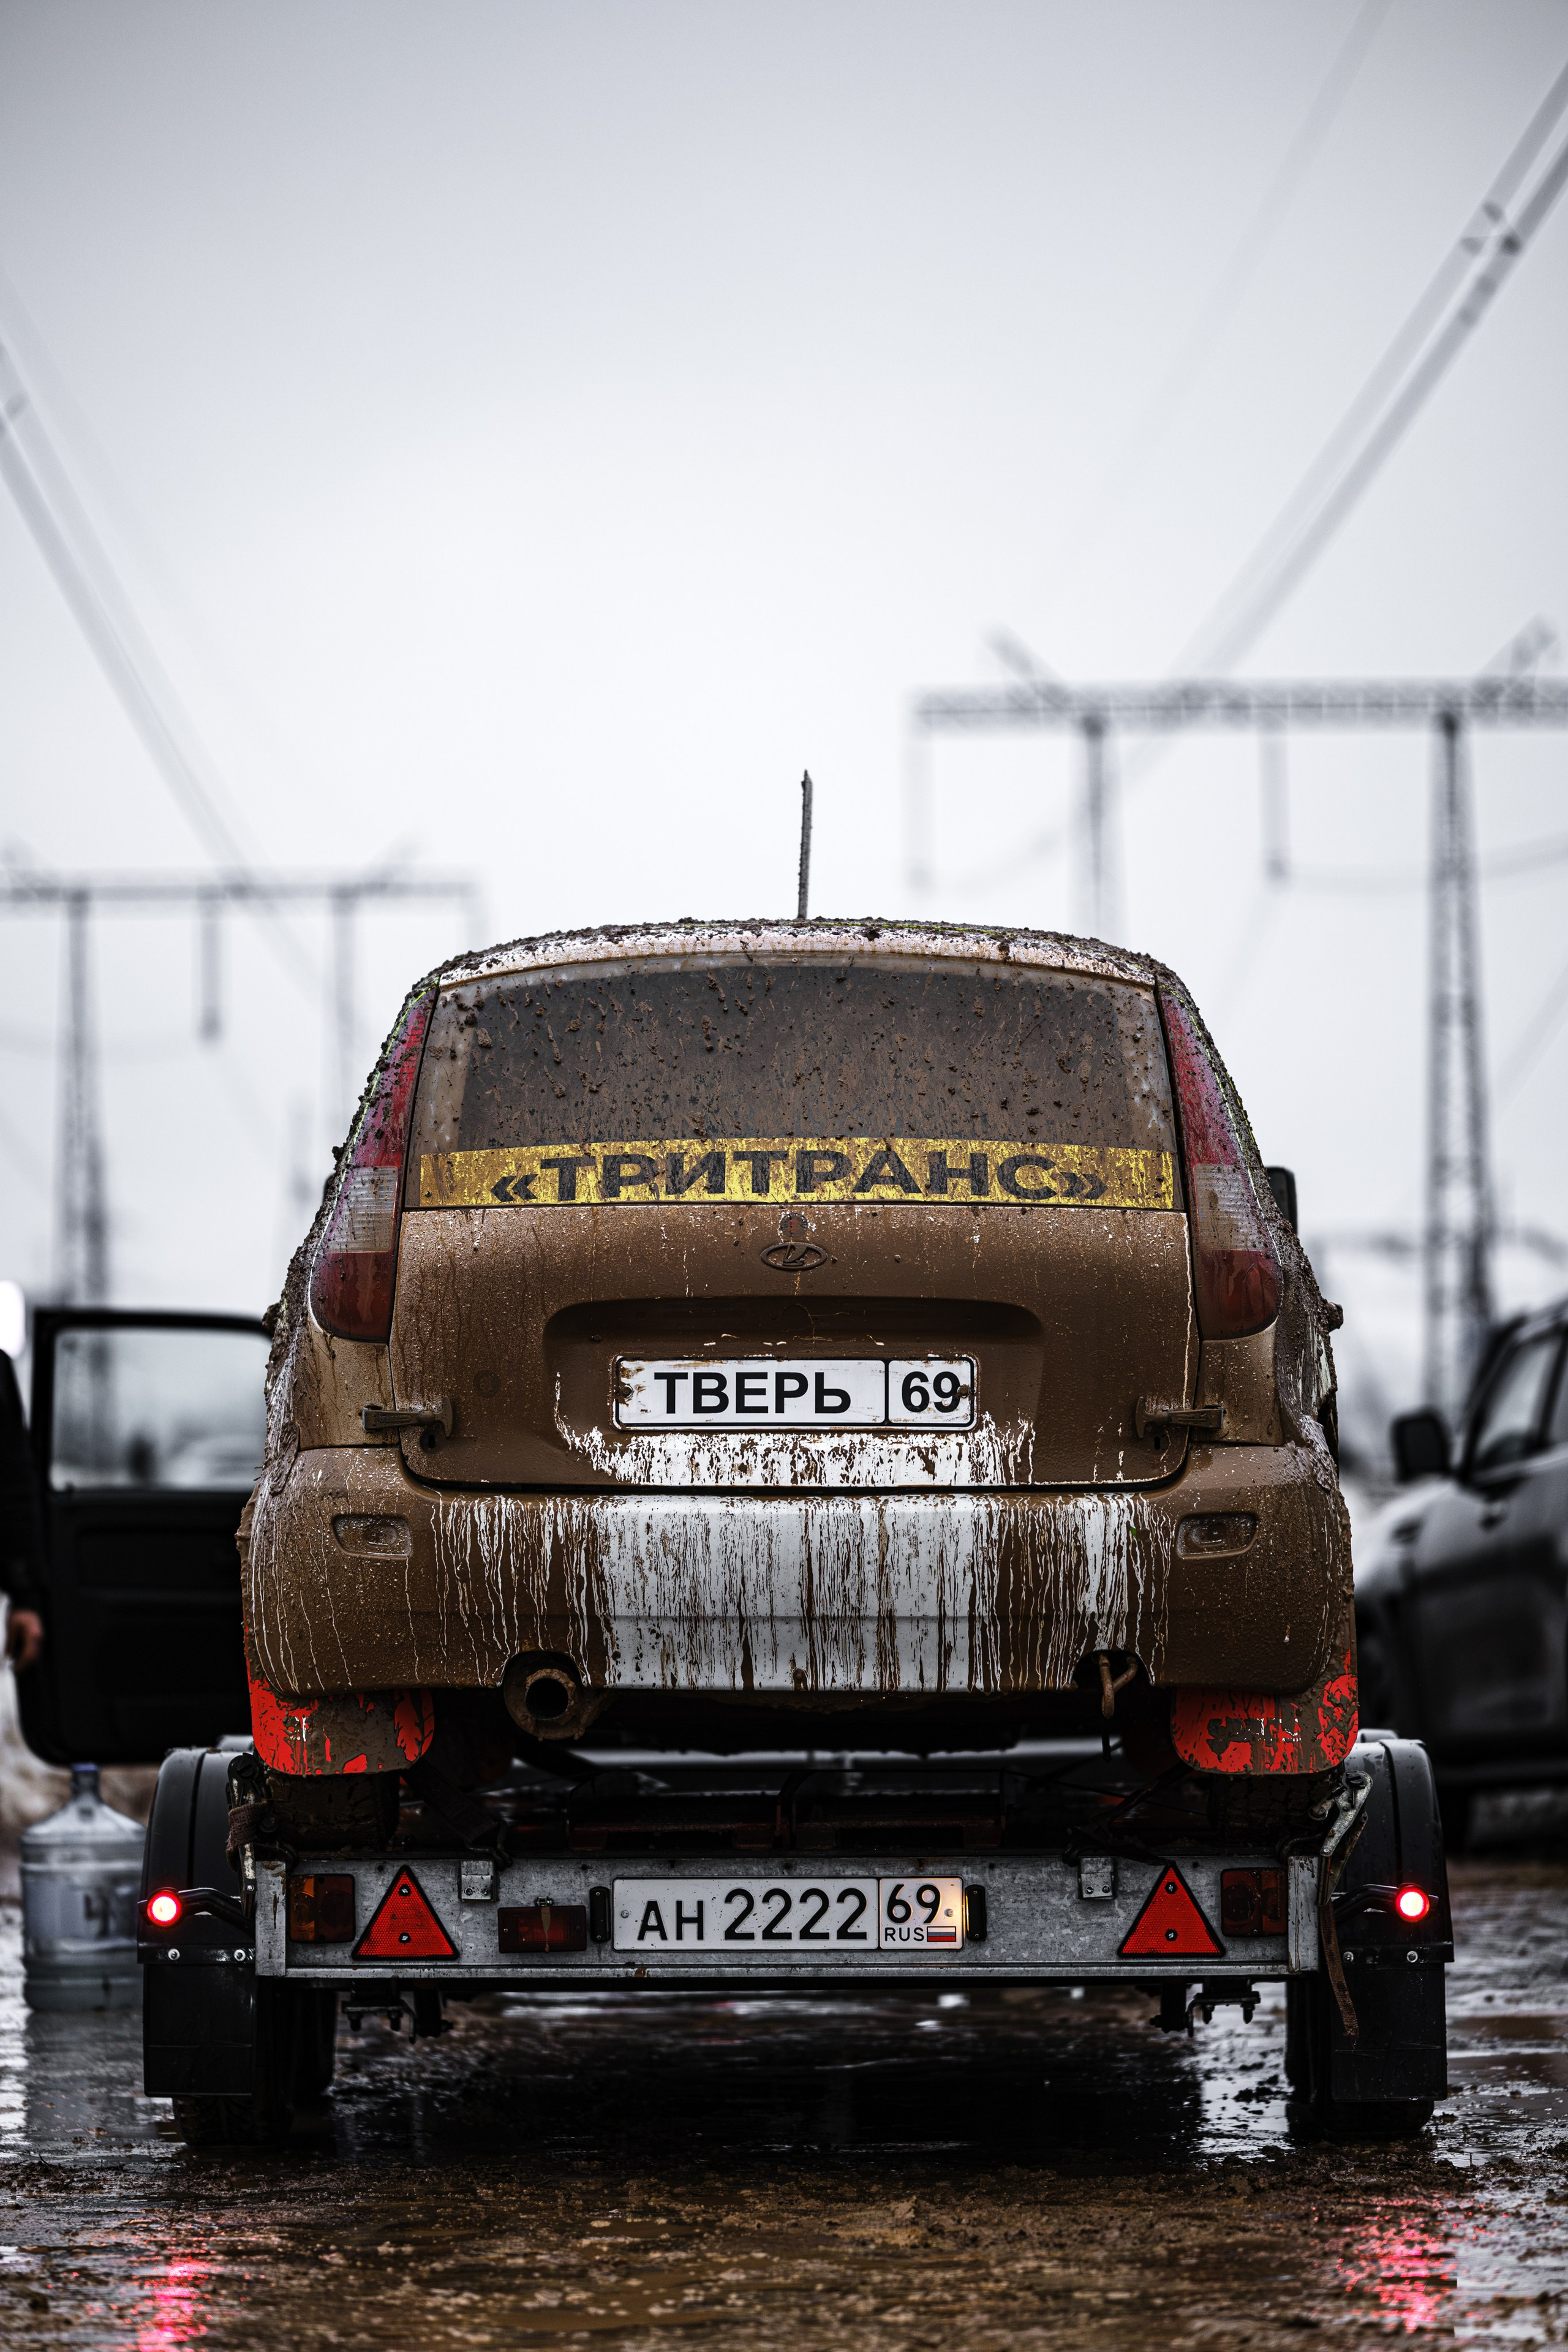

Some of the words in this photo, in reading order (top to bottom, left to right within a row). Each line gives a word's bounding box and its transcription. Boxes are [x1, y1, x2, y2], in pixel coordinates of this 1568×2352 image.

[654, 1371, 851, 1414] ТВЕРЬ
[901, 1371, 960, 1414] 69
[723, 1888, 868, 1940] 2222
[886, 1883, 941, 1924] 69
[884, 1927, 925, 1942] RUS
